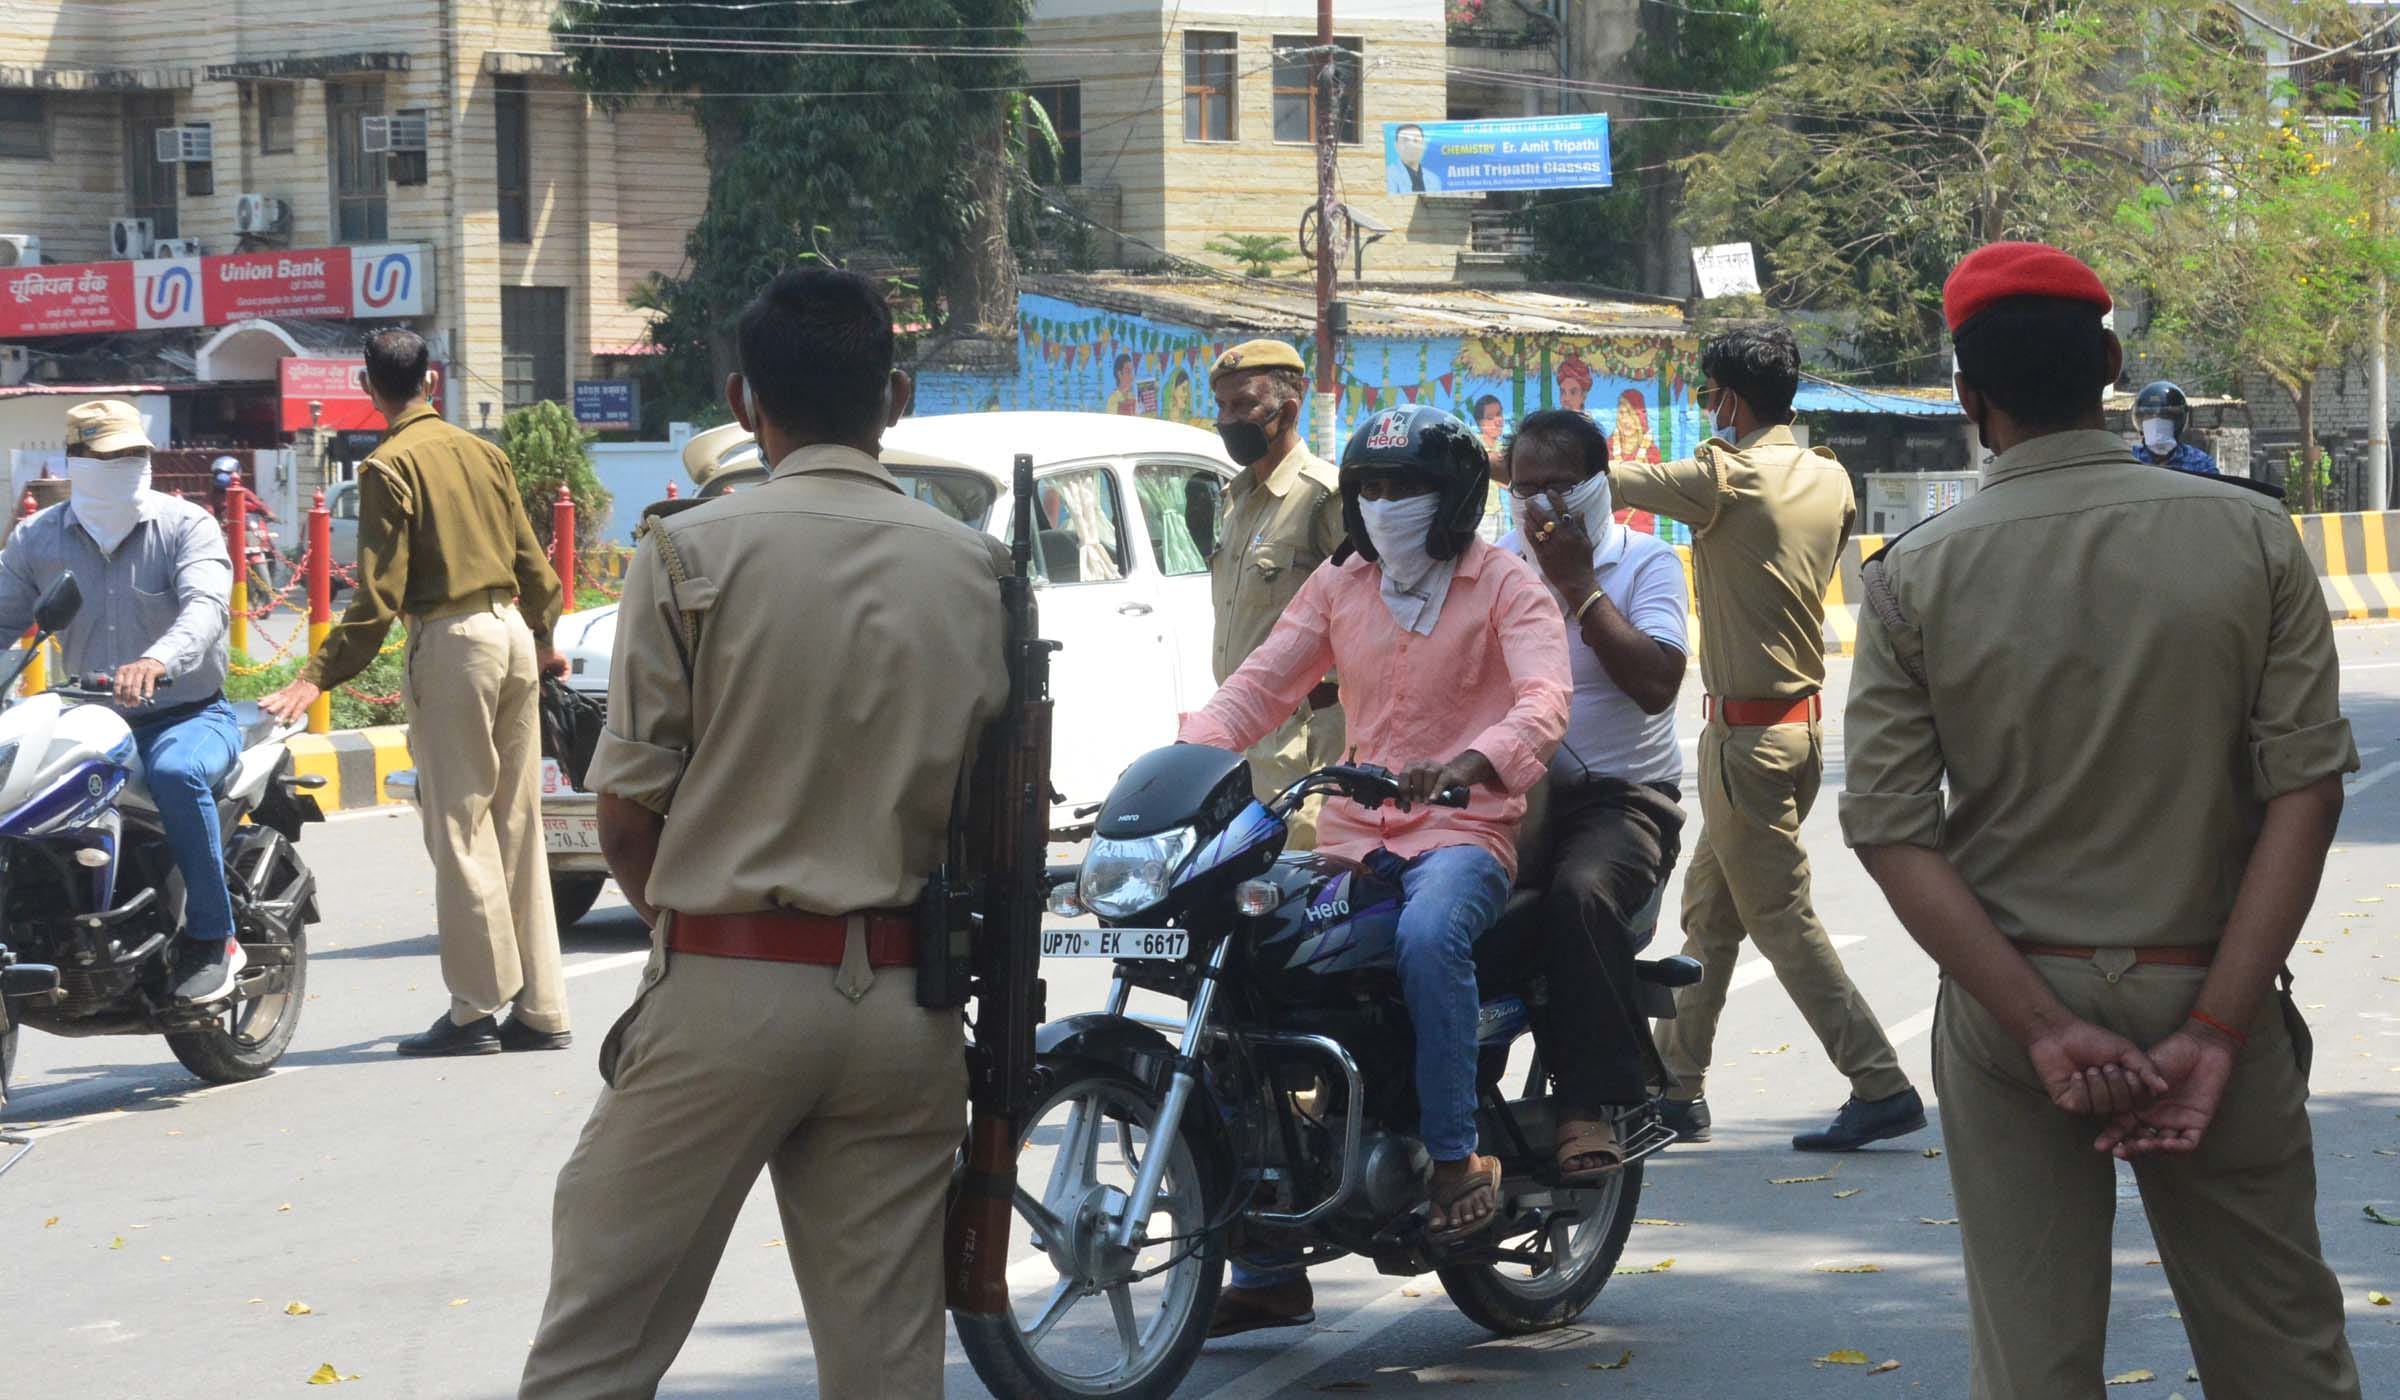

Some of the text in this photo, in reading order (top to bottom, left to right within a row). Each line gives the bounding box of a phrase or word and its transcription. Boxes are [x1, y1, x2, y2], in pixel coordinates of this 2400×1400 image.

[1441, 143, 1496, 155] CHEMISTRY
[1503, 137, 1599, 153] Er. Amit Tripathi
[1447, 161, 1600, 177] Amit Tripathi Classes
[220, 257, 324, 282] Union Bank
[9, 268, 109, 303] यूनियन बैंक
[1367, 434, 1408, 447] Hero
[1305, 899, 1350, 922] Hero
[1043, 932, 1185, 955] UP70 EK 6617
